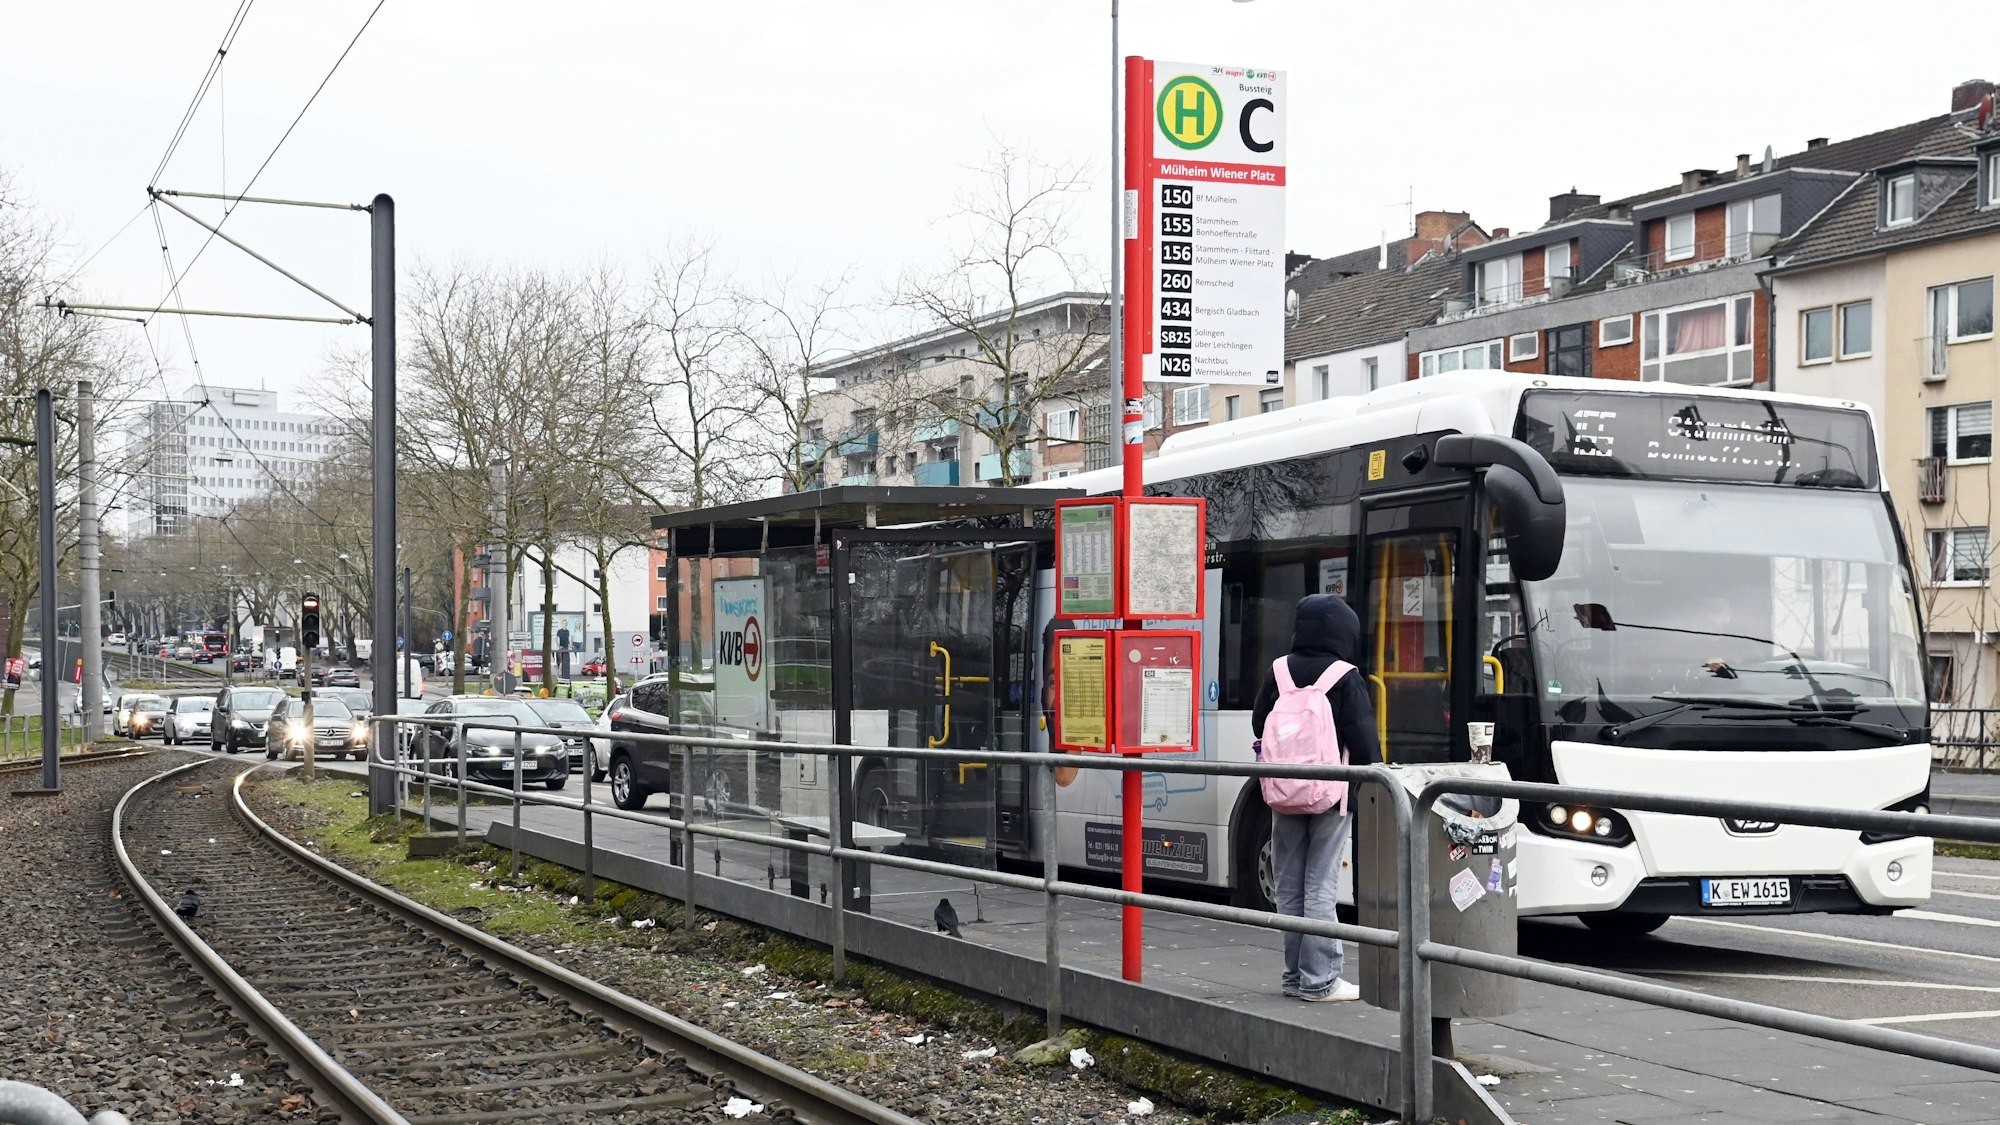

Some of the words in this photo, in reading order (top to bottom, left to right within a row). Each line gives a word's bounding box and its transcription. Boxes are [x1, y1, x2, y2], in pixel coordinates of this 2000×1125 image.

[1239, 84, 1272, 95] Bussteig
[1176, 90, 1205, 135] H
[1239, 98, 1274, 152] C
[1160, 164, 1208, 177] Mülheim
[1210, 167, 1248, 179] Wiener
[1250, 170, 1276, 181] Platz
[1164, 188, 1192, 205] 150
[1206, 194, 1237, 204] Mülheim
[1164, 216, 1192, 233] 155
[1196, 216, 1238, 226] Stammheim
[1196, 228, 1258, 239] Bonhoefferstraße
[1163, 245, 1191, 261] 156
[1196, 244, 1238, 254] Stammheim
[1245, 247, 1270, 256] Flittard
[1196, 256, 1227, 265] Mülheim
[1230, 258, 1255, 266] Wiener
[1257, 260, 1274, 268] Platz
[1162, 273, 1191, 289] 260
[1196, 278, 1234, 288] Remscheid
[1162, 301, 1190, 317] 434
[1195, 306, 1225, 316] Bergisch
[1227, 308, 1260, 317] Gladbach
[1161, 331, 1191, 344] SB25
[1194, 328, 1225, 338] Solingen
[1214, 341, 1253, 351] Leichlingen
[1162, 357, 1191, 372] N26
[1194, 356, 1228, 365] Nachtbus
[1194, 368, 1252, 377] Wermelskirchen
[720, 630, 742, 666] KVB
[1712, 883, 1721, 899] K
[1732, 883, 1750, 899] EW
[1753, 882, 1788, 898] 1615
